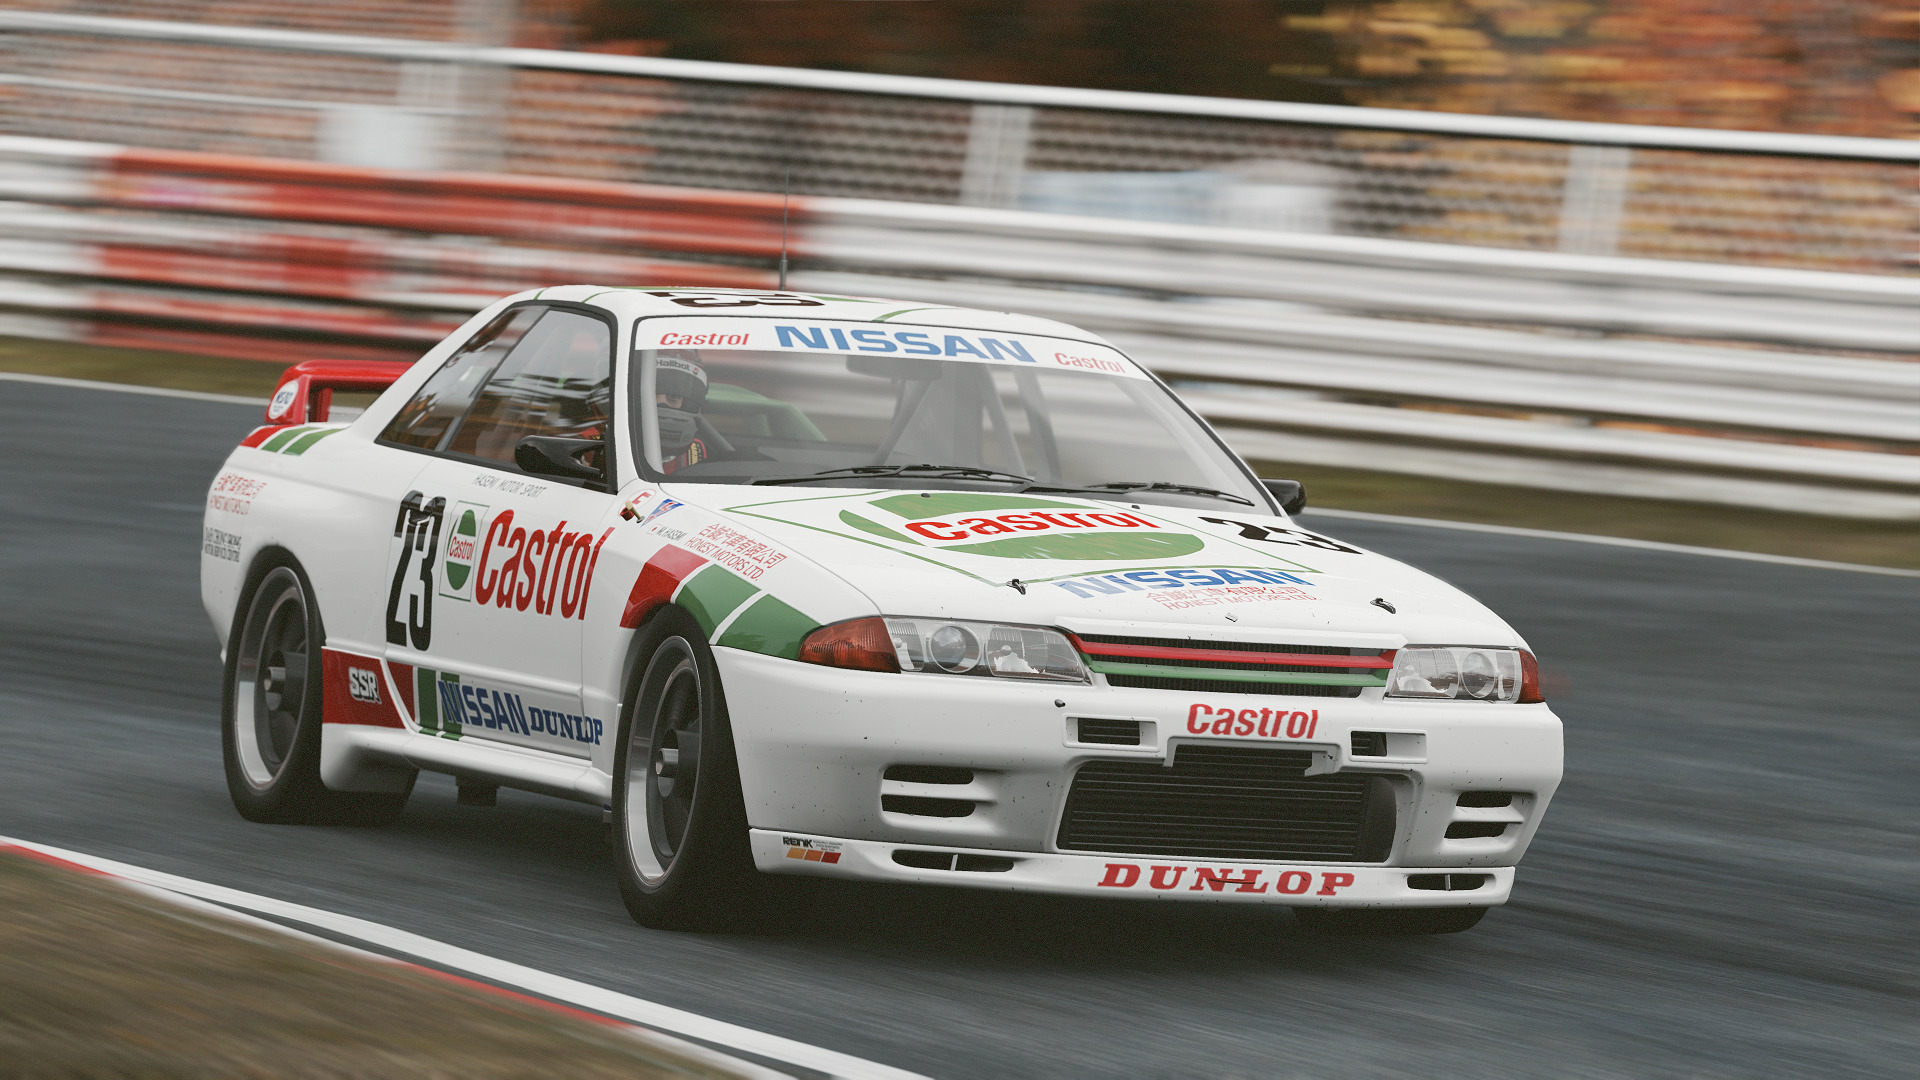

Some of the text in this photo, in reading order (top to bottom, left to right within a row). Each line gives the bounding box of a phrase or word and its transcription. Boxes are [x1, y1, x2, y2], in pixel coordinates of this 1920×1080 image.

[659, 332, 749, 348] Castrol
[774, 325, 1038, 362] NISSAN
[1054, 352, 1127, 374] Castrol
[905, 511, 1161, 541] Castrol
[1198, 516, 1364, 554] 23
[449, 535, 476, 561] Castrol
[475, 508, 616, 621] Castrol
[684, 536, 720, 555] HONEST
[710, 547, 750, 572] MOTORS
[386, 489, 447, 652] 23
[1051, 569, 1316, 599] NISSAN
[1162, 597, 1225, 611] HONEST
[1224, 594, 1291, 604] MOTORS
[349, 667, 382, 705] SSR
[438, 680, 604, 746] NISSAN DUNLOP
[1186, 703, 1319, 739] Castrol
[1097, 863, 1355, 896] DUNLOP
